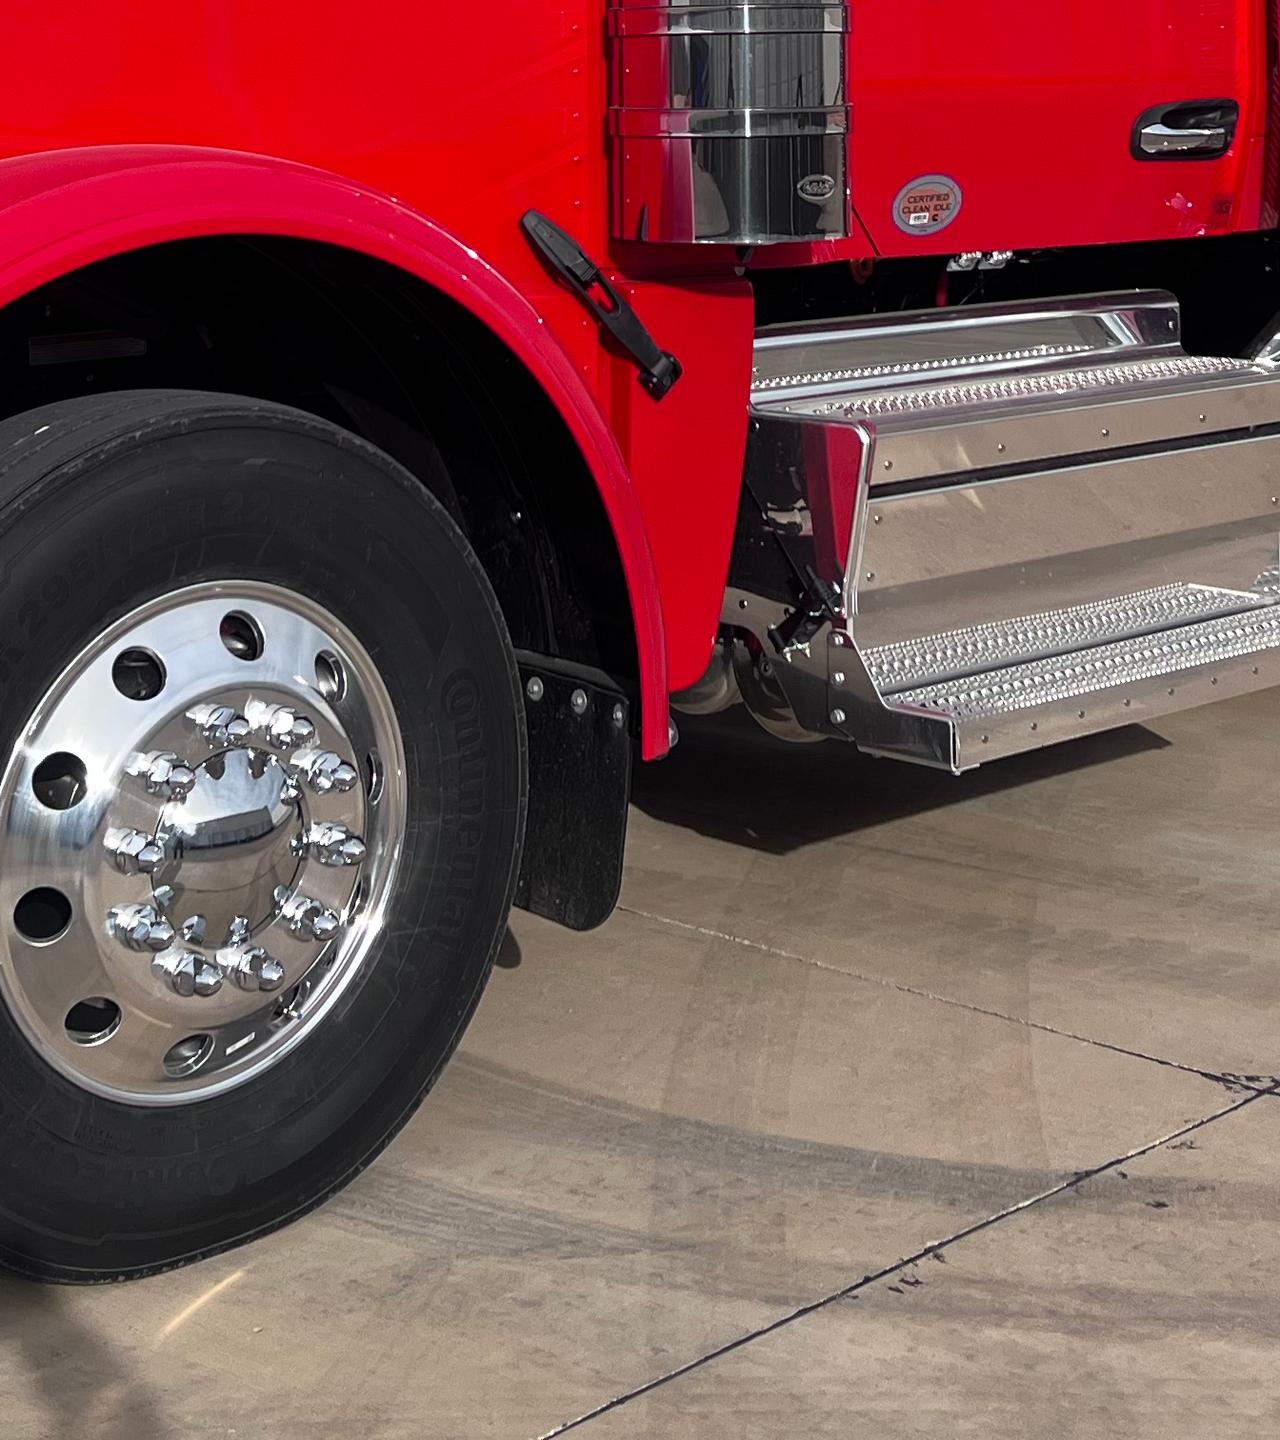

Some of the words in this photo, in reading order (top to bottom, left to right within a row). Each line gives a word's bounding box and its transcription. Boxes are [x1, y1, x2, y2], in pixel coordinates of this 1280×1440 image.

[907, 193, 950, 203] CERTIFIED
[902, 205, 930, 214] CLEAN
[933, 203, 951, 211] IDLE
